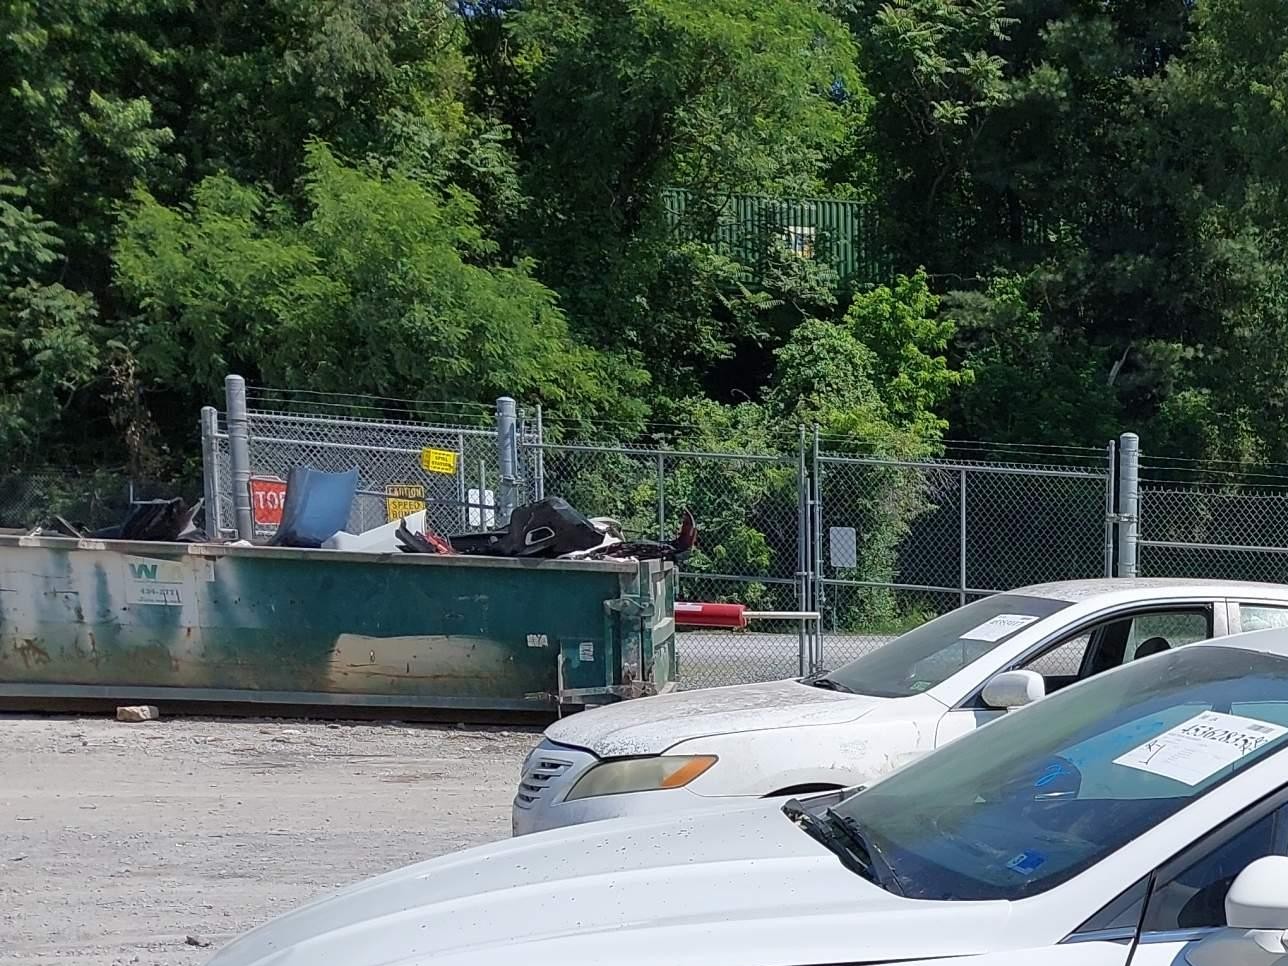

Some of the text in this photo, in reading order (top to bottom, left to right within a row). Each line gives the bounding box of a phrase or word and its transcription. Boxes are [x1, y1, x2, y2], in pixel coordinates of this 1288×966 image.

[388, 487, 423, 498] CAUTION
[255, 491, 286, 510] TOP
[392, 501, 421, 510] SPEED
